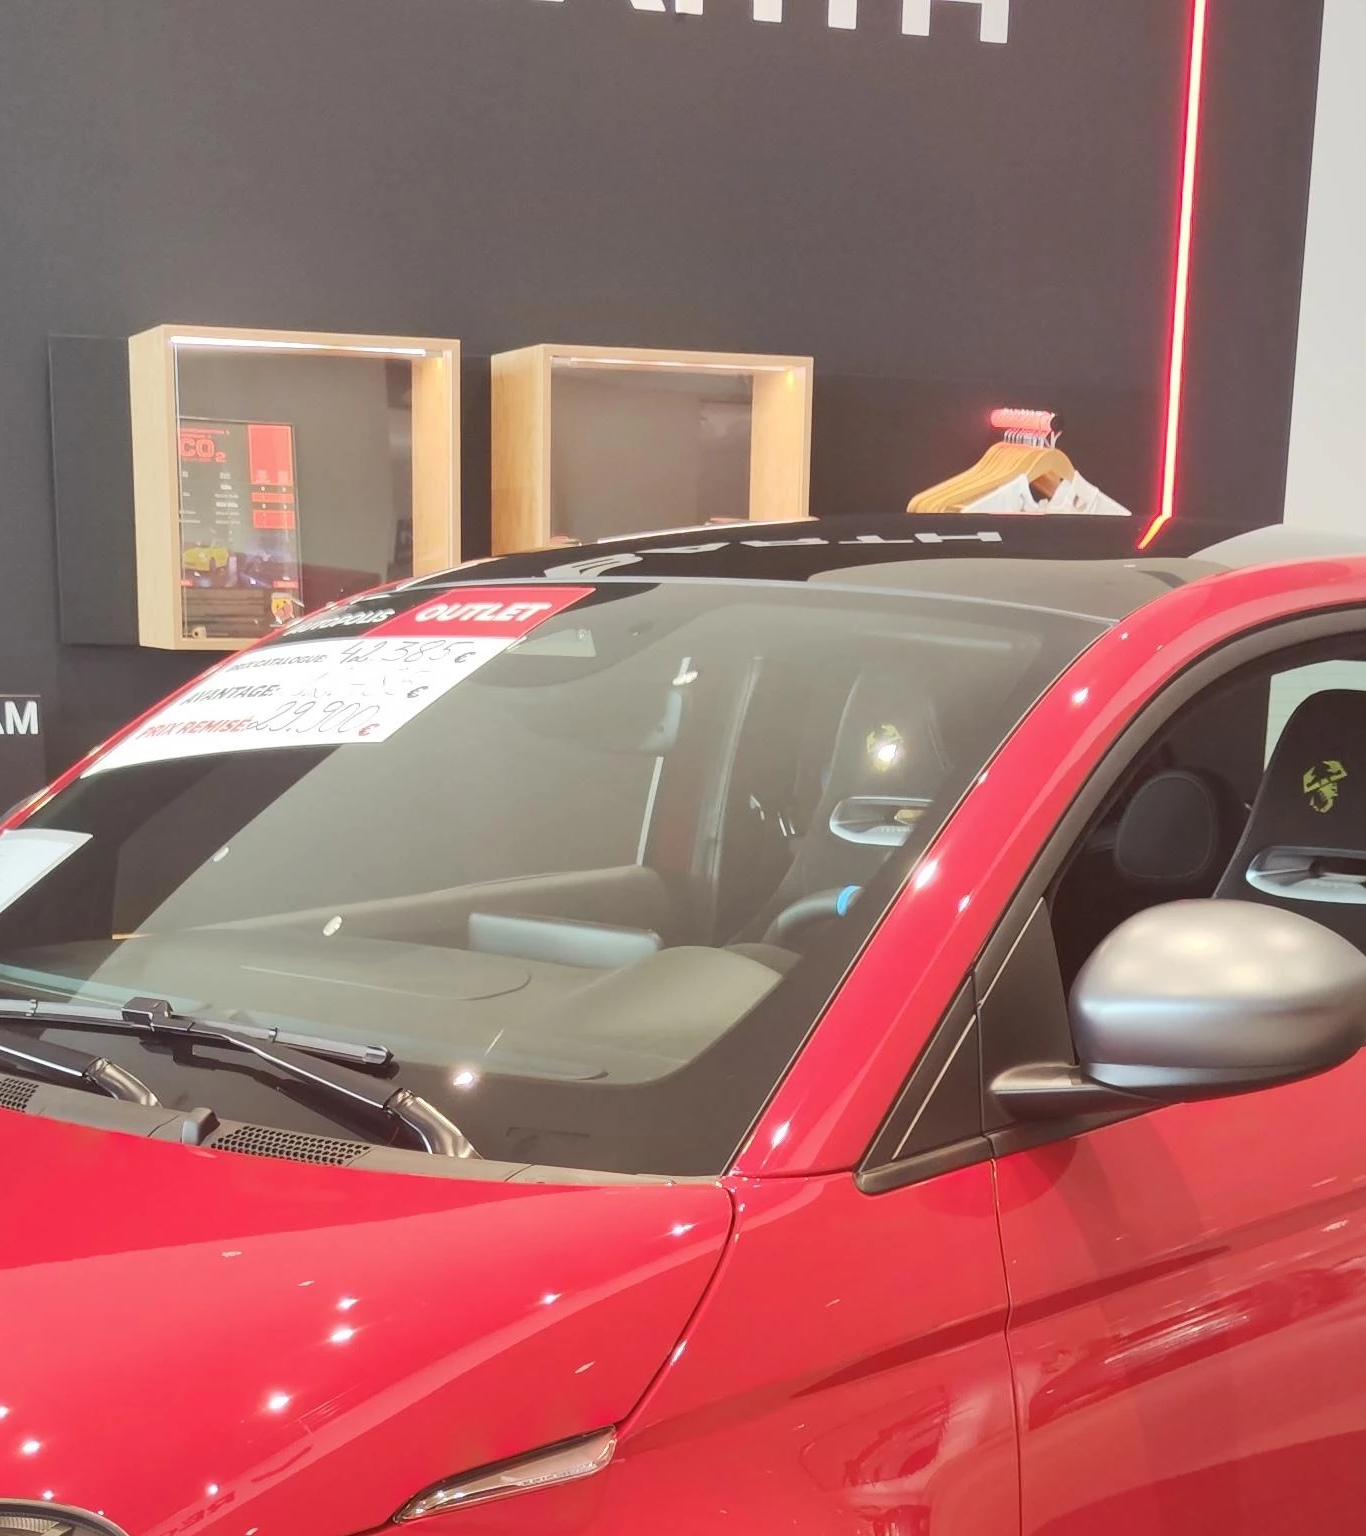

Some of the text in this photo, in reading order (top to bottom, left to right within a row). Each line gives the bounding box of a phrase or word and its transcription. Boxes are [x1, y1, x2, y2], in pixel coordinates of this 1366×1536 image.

[415, 602, 554, 623] OUTLET
[455, 652, 476, 664] €
[179, 684, 282, 705] AVANTAGE:
[407, 686, 429, 698] €
[136, 722, 184, 740] PRIX
[359, 723, 380, 736] €
